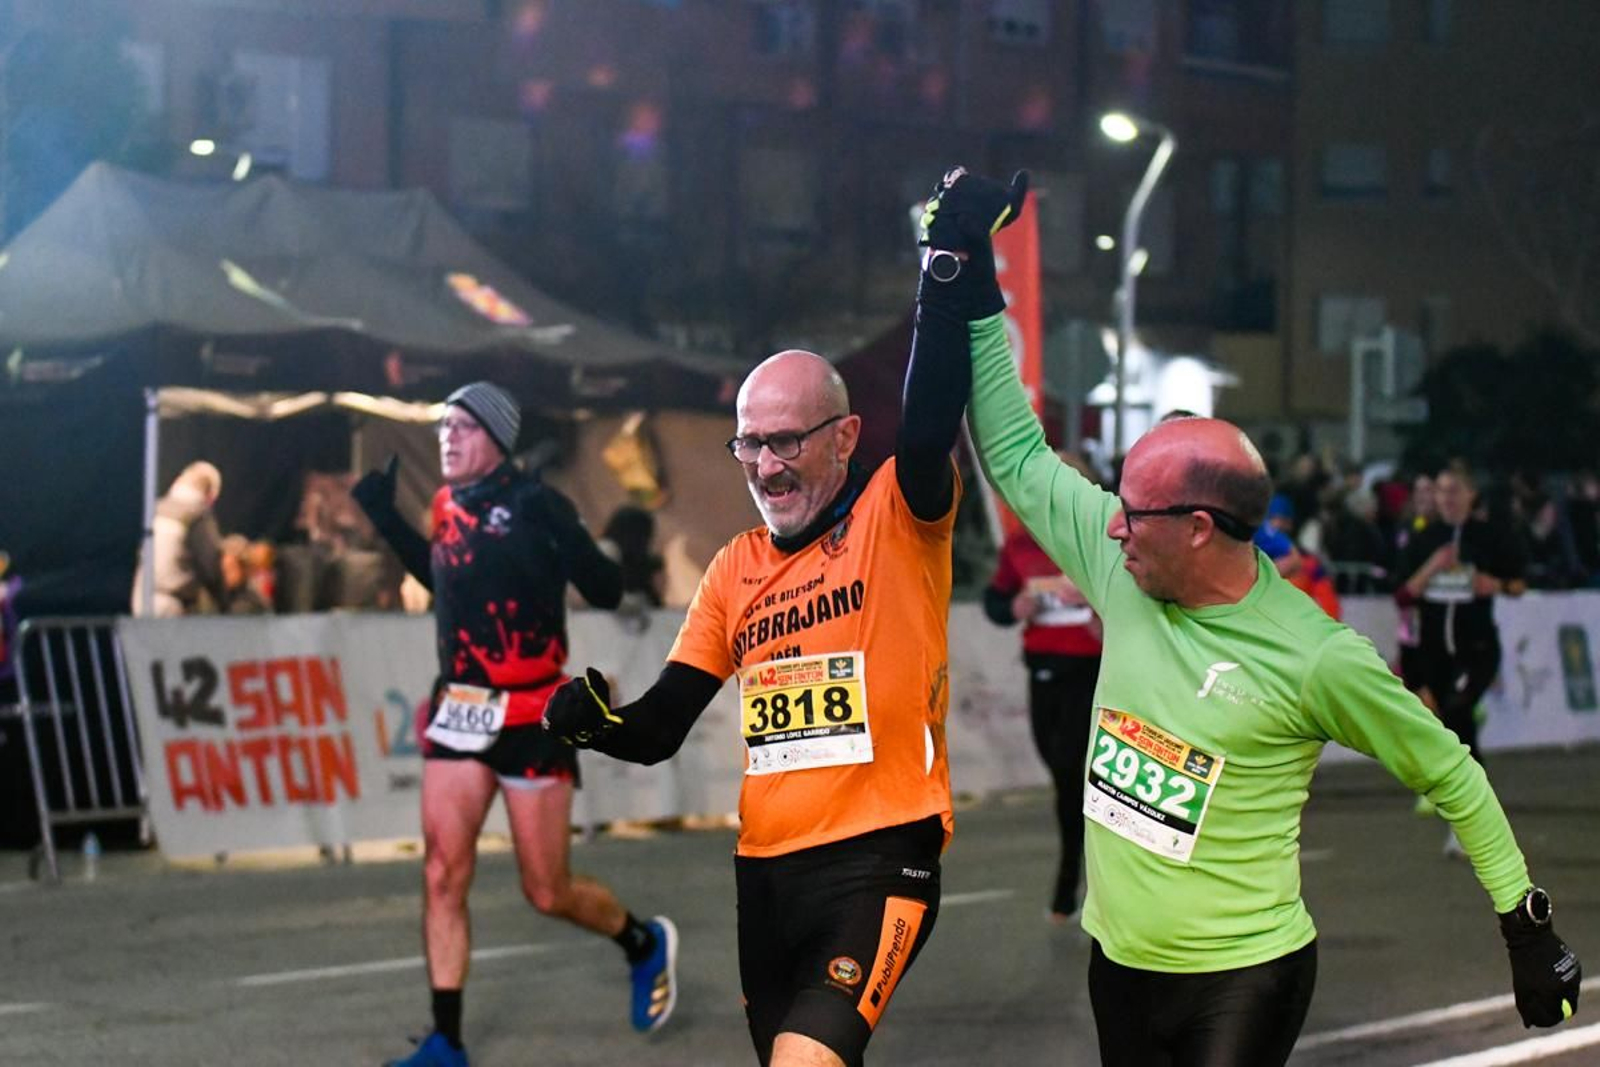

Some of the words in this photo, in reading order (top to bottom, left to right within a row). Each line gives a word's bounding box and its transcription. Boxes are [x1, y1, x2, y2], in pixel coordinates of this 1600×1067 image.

[765, 593, 777, 607] DE
[152, 656, 225, 729] 42
[226, 655, 348, 731] SAN
[749, 686, 853, 733] 3818
[164, 731, 361, 813] ANTON
[1092, 735, 1197, 819] 2932
